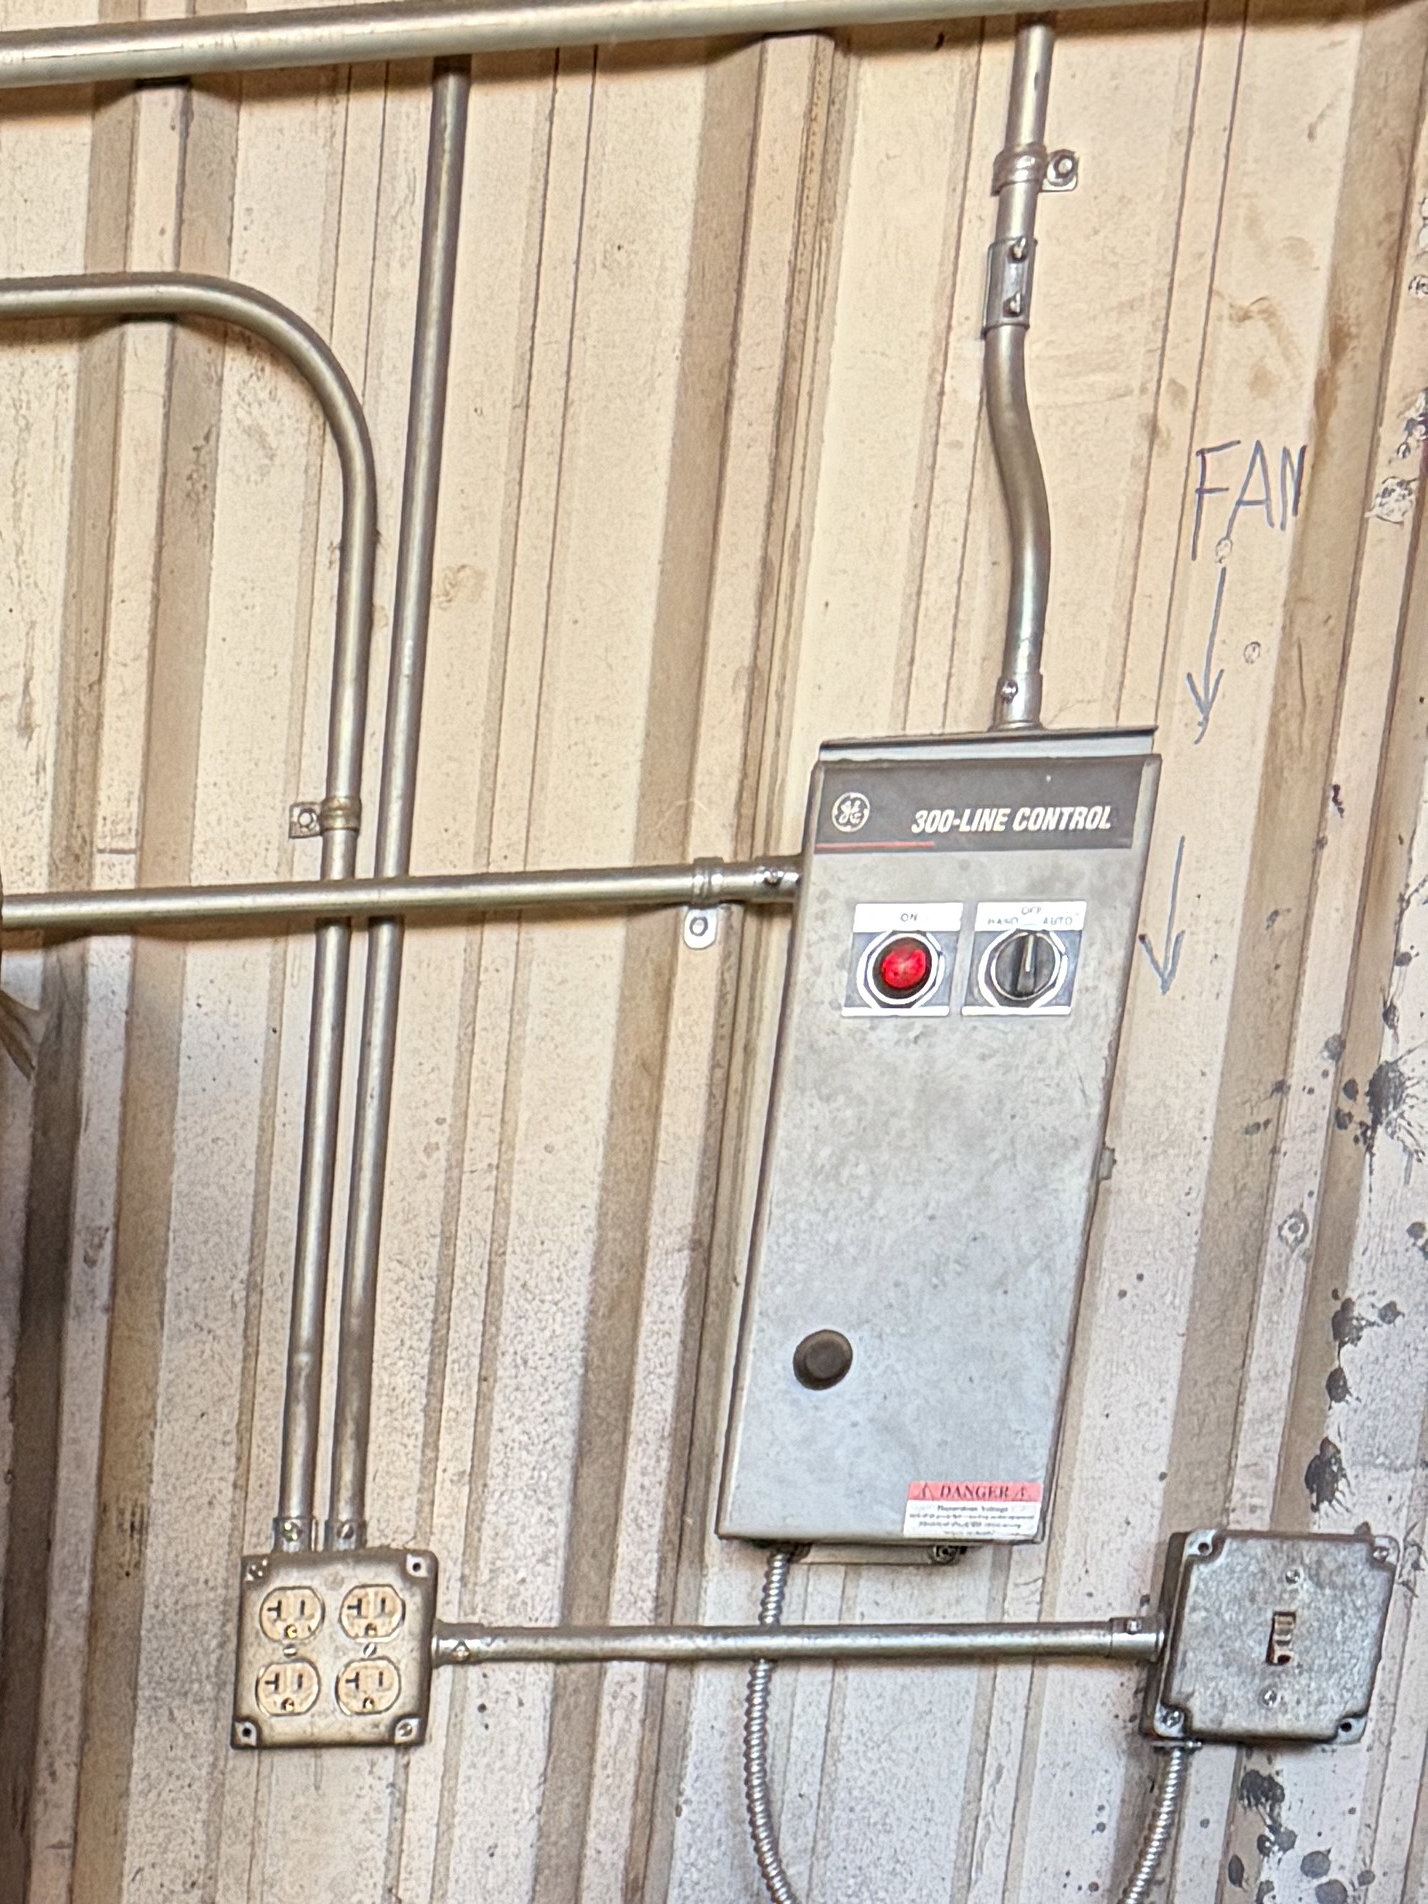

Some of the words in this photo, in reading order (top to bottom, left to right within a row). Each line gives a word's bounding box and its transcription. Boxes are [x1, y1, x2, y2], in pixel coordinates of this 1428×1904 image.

[1192, 439, 1308, 561] FAN
[910, 807, 1011, 834] 300-LINE
[1011, 804, 1112, 832] CONTROL
[900, 912, 919, 922] ON
[939, 1484, 1010, 1499] DANGER
